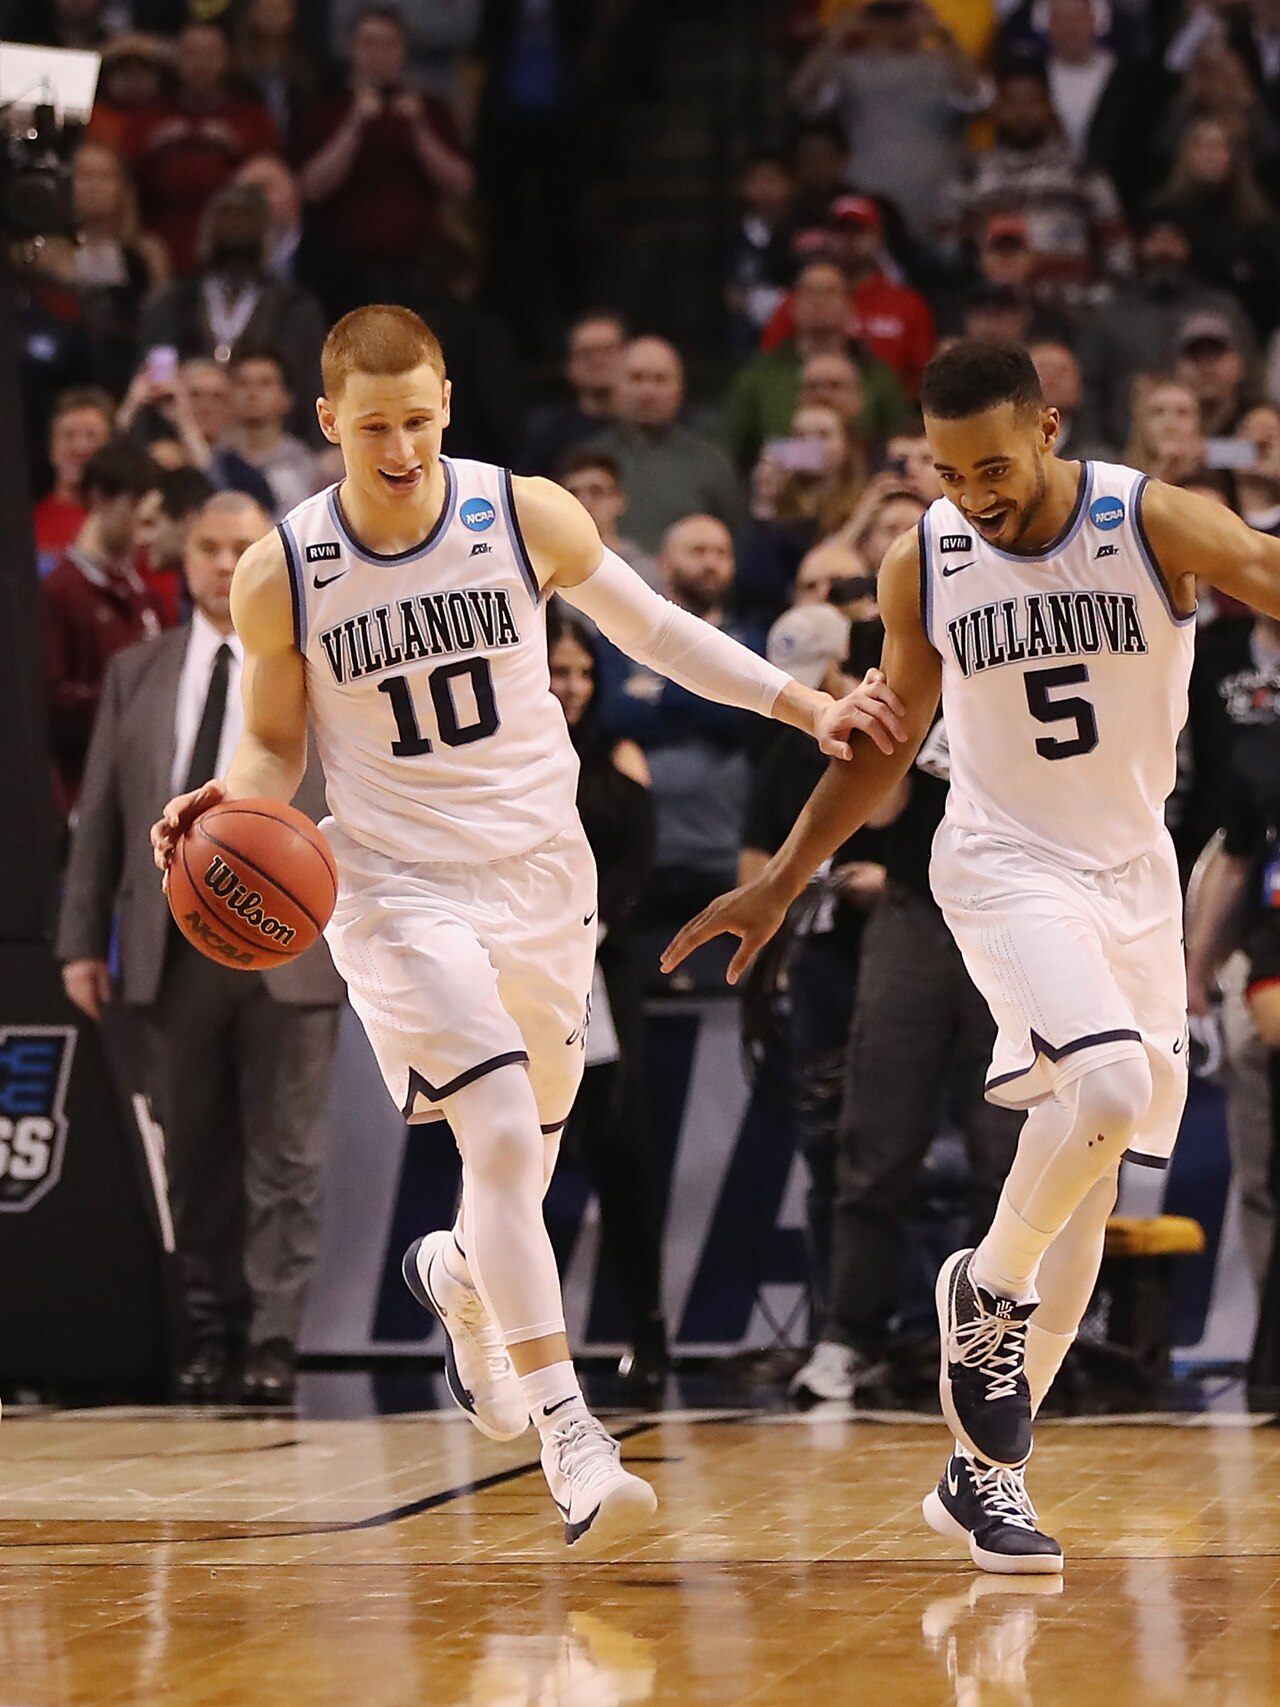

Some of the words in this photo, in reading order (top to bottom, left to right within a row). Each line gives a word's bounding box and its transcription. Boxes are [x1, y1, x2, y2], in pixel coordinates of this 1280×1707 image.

[466, 510, 495, 524] NCAA
[943, 537, 967, 549] RVM
[1096, 508, 1124, 523] NCAA
[310, 546, 335, 559] RVM
[319, 589, 521, 685] VILLANOVA
[946, 590, 1149, 679] VILLANOVA
[377, 656, 500, 757] 10
[1023, 663, 1099, 760] 5
[204, 855, 296, 946] Wilson
[185, 911, 255, 966] NCAA
